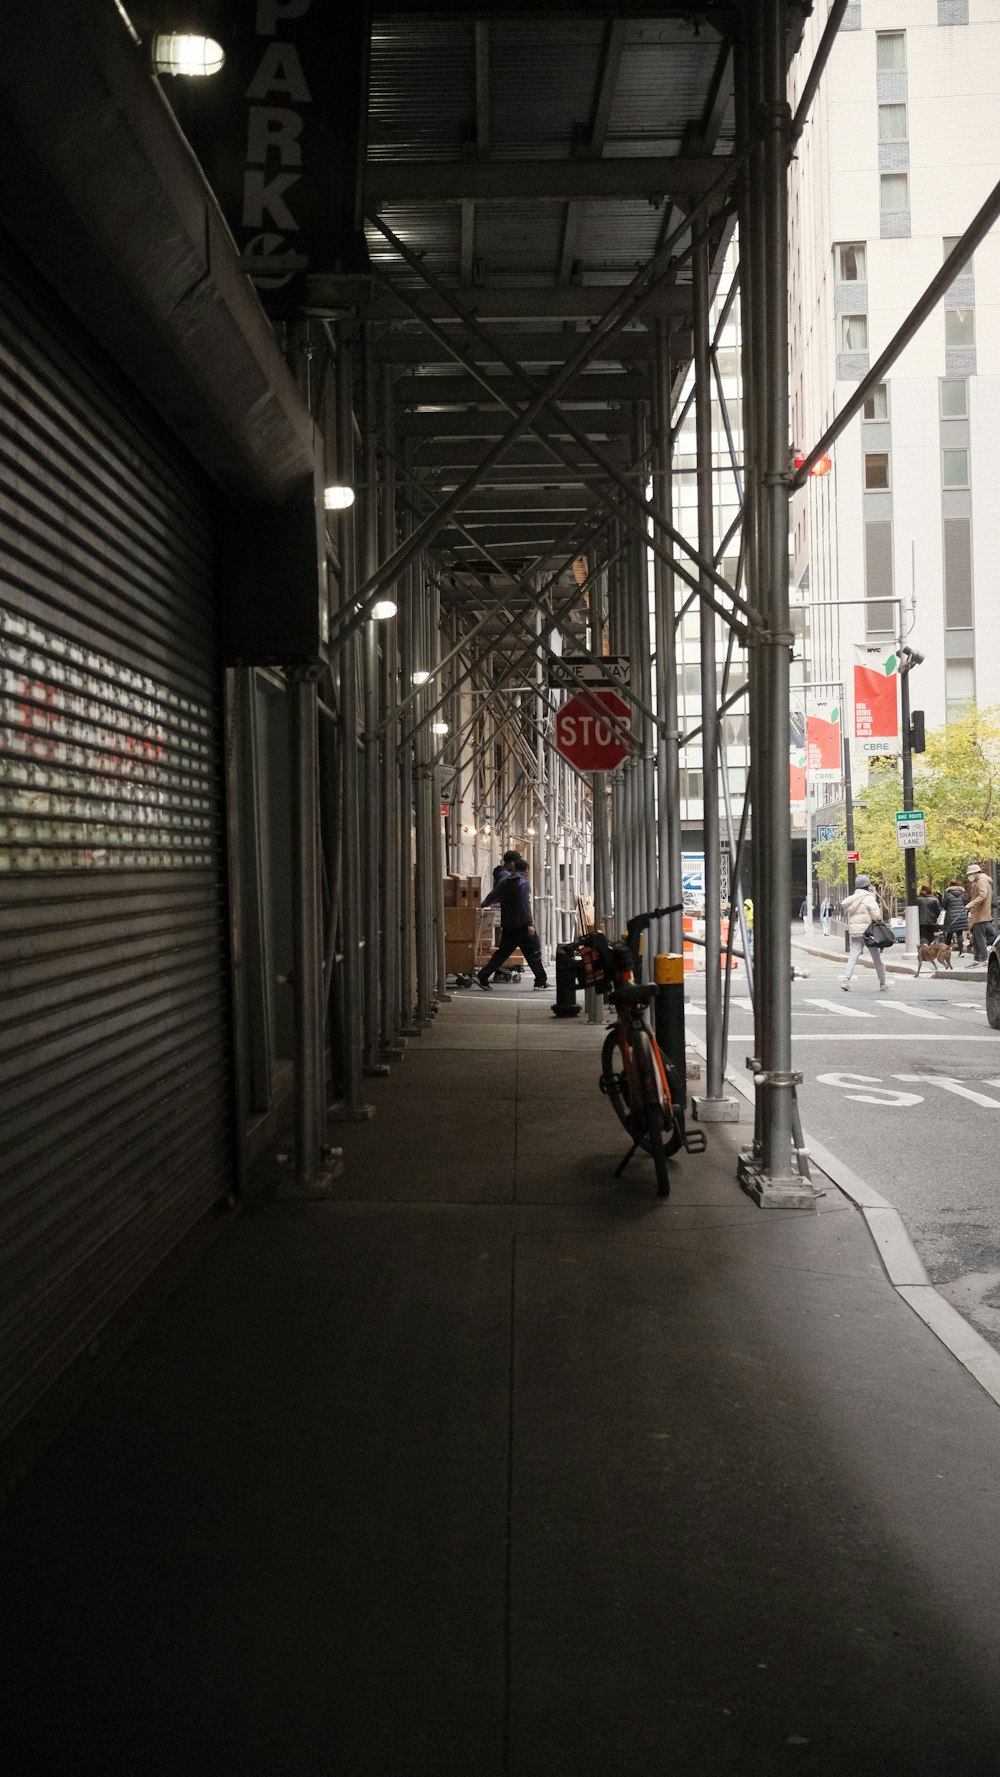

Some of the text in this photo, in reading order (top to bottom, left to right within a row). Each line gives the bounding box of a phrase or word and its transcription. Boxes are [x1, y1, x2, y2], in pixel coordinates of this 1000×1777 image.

[245, 0, 312, 230] PARK
[561, 716, 631, 746] STOP
[863, 743, 889, 751] CBRE
[900, 831, 923, 839] SHARED
[816, 1072, 1000, 1109] ST
